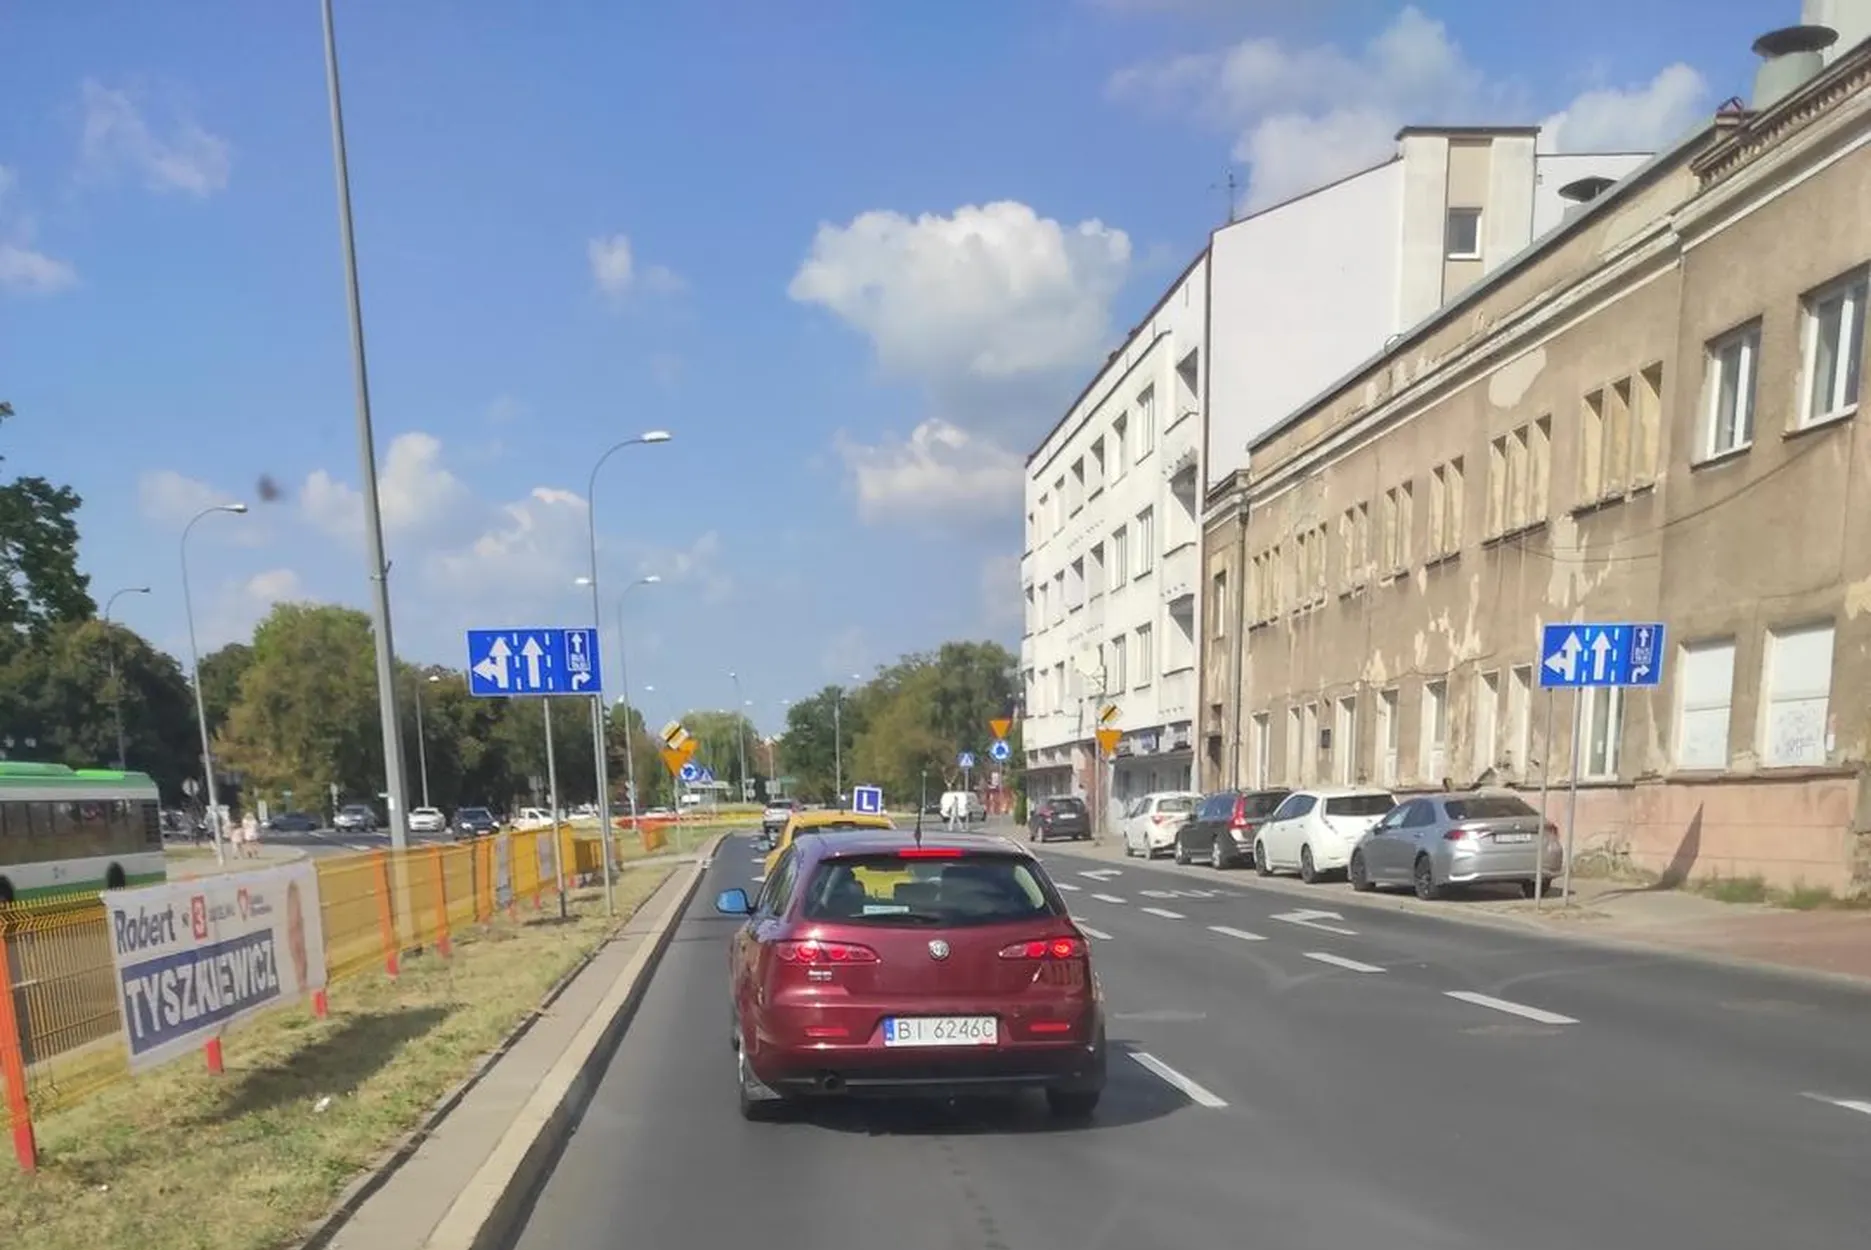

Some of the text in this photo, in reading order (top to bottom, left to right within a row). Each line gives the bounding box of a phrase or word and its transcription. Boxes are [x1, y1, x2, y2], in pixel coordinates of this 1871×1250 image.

[862, 792, 874, 810] L
[114, 904, 176, 954] Robert
[125, 941, 276, 1038] TYSZKIEWICZ
[898, 1021, 922, 1040] BI
[934, 1019, 994, 1038] 6246C
